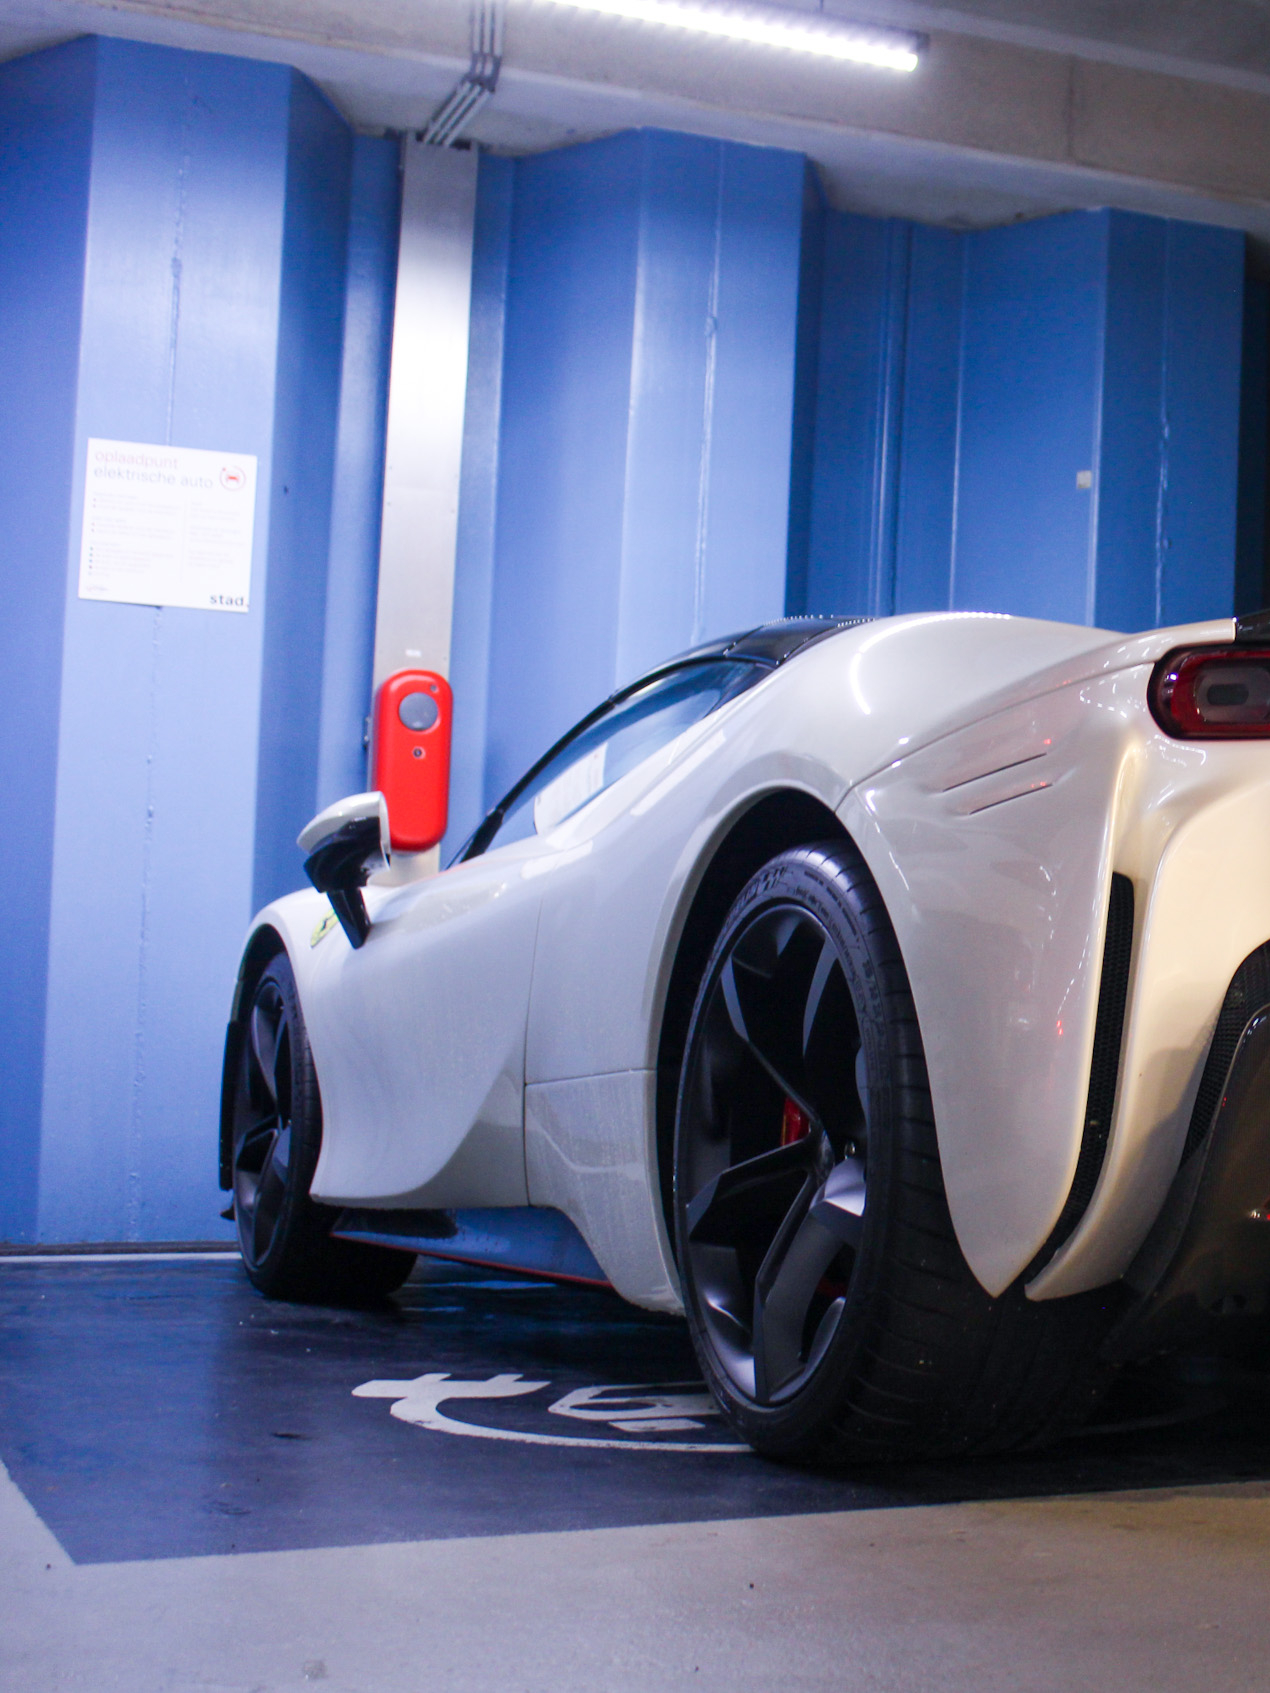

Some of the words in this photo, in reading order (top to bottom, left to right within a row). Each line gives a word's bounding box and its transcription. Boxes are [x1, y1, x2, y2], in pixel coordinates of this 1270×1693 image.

[95, 449, 178, 469] oplaadpunt
[94, 466, 175, 485] elektrische
[180, 475, 213, 488] auto
